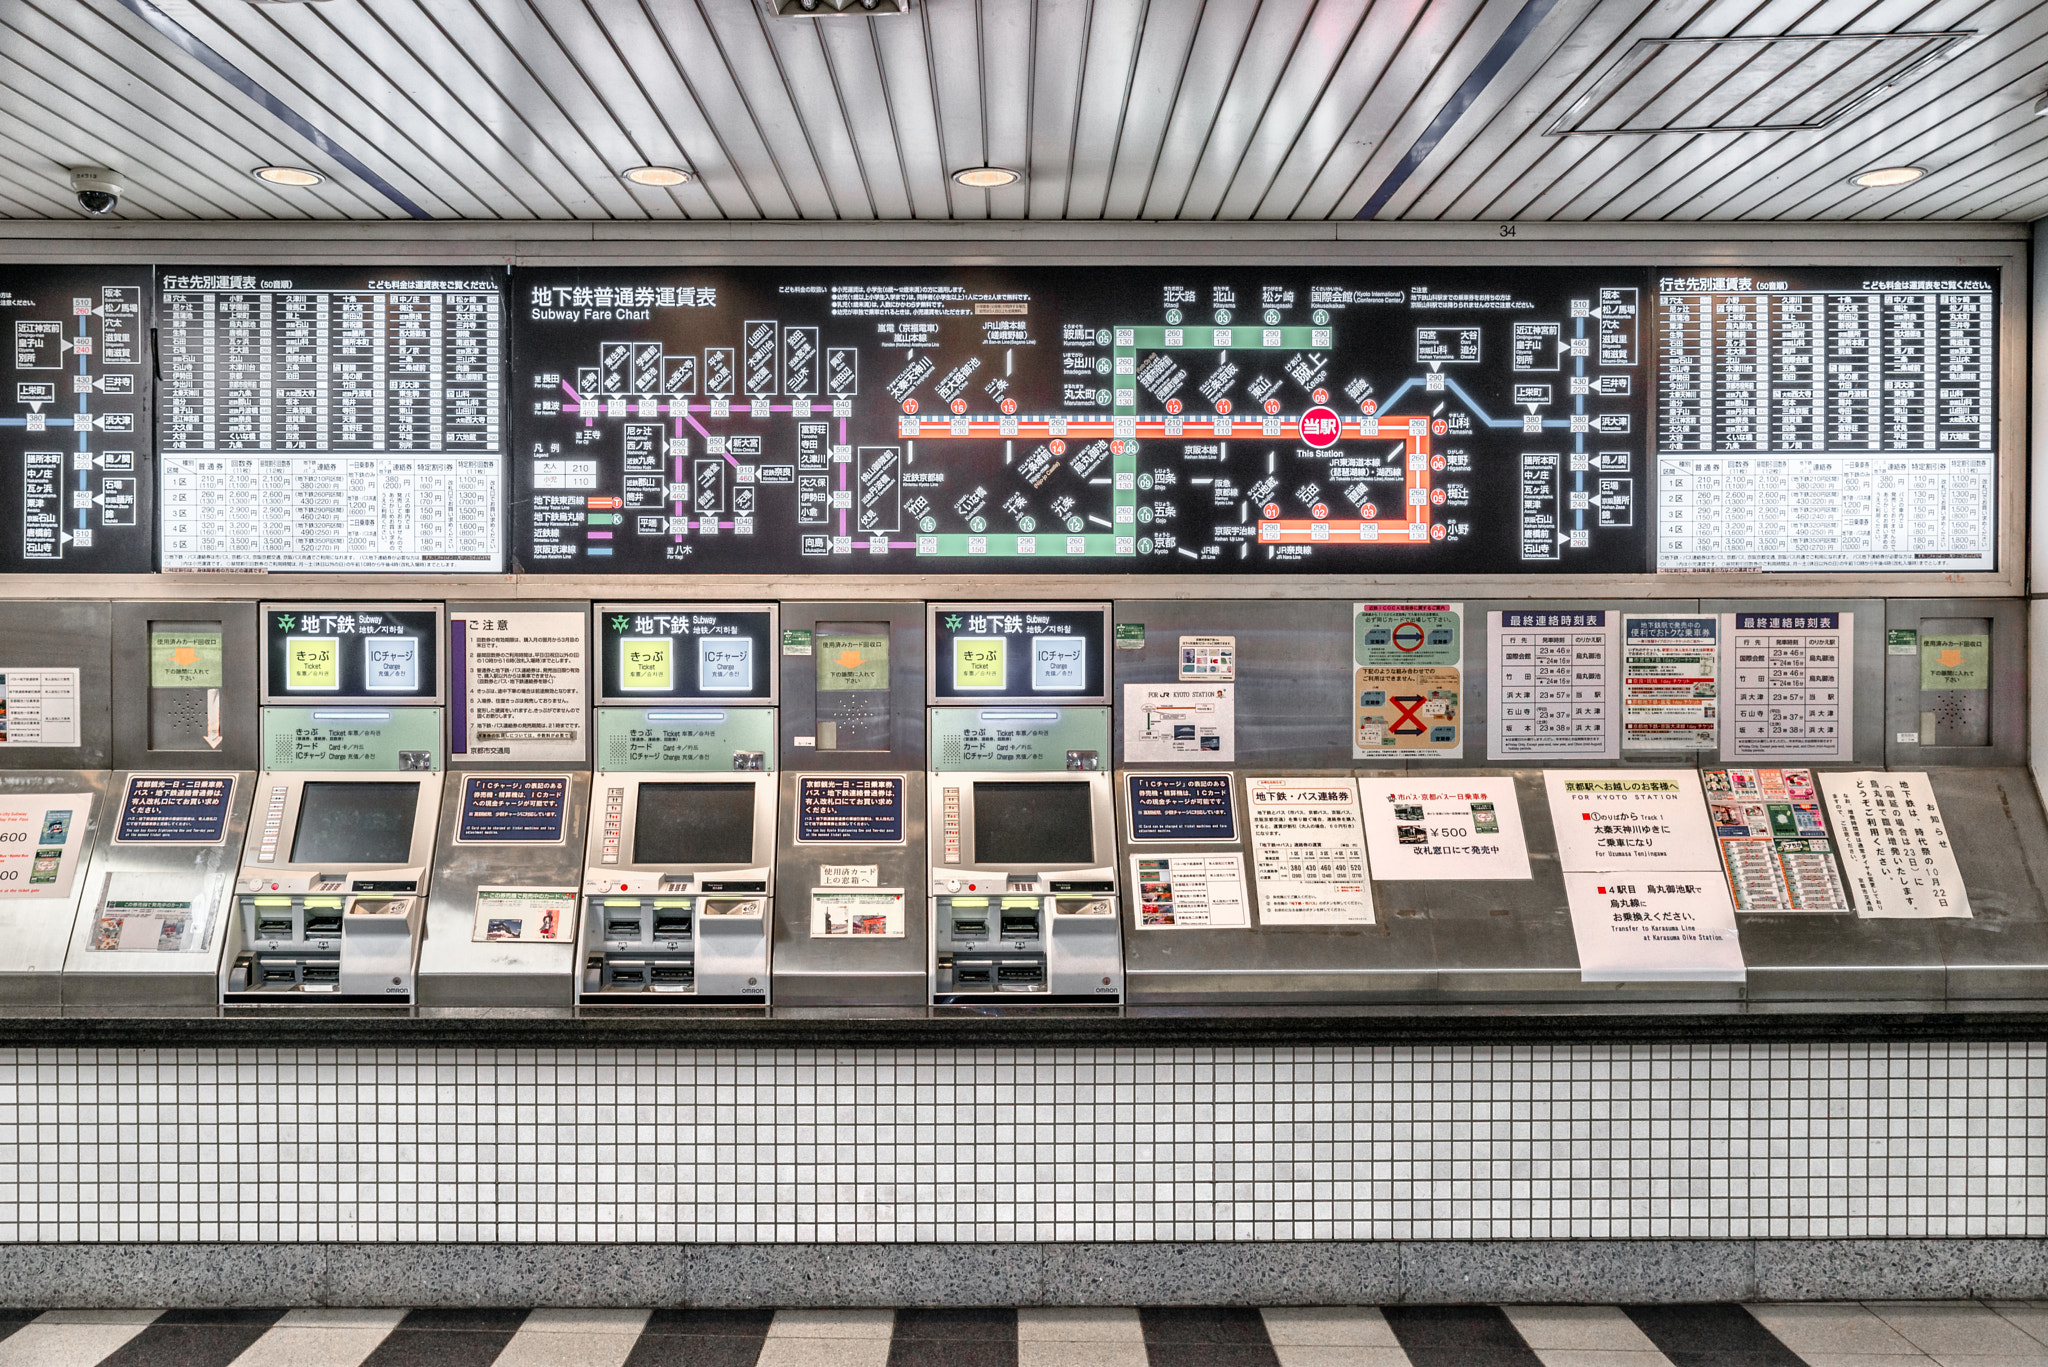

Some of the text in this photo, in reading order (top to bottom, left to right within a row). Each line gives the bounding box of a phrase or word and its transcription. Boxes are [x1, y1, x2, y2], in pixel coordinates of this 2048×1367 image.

[1500, 225, 1516, 237] 34
[163, 276, 256, 289] 行き先別運賃表
[368, 280, 499, 290] こども料金は運賃表をご覧ください。
[1660, 277, 1752, 291] 行き先別運賃表
[1863, 281, 1991, 290] こども料金は運賃表をご覧ください。
[105, 289, 122, 297] 坂本
[532, 286, 717, 308] 地下鉄普通券運賃表
[1164, 290, 1196, 302] 北大路
[1214, 291, 1234, 302] 北山
[1263, 291, 1294, 302] 松ヶ崎
[1312, 292, 1352, 302] 国際会館
[1603, 291, 1619, 299] 坂本
[531, 308, 650, 321] Subway Fare Chart
[1603, 321, 1619, 329] 穴太
[1064, 329, 1095, 340] 鞍馬口
[1461, 331, 1477, 339] 大谷
[1517, 326, 1557, 335] 近江神宮前
[1573, 339, 1587, 347] 460
[1461, 346, 1477, 354] 追分
[1064, 357, 1095, 368] 今出川
[1517, 356, 1533, 365] 別所
[105, 378, 130, 386] 三井寺
[1305, 370, 1327, 392] Keage
[1428, 374, 1442, 382] 290
[1602, 379, 1627, 387] 三井寺
[1064, 389, 1095, 399] 丸太町
[1518, 388, 1542, 397] 上栄町
[105, 416, 130, 425] 浜大津
[1449, 418, 1470, 428] 山科
[1602, 417, 1627, 426] 浜大津
[1304, 420, 1336, 435] 当駅
[627, 441, 652, 450] 西ノ京
[733, 438, 758, 448] 新大宮
[801, 440, 818, 449] 寺田
[1185, 446, 1217, 454] 京阪本線
[801, 455, 826, 464] 久津川
[1448, 455, 1468, 466] 東野
[1602, 456, 1627, 465] 島ノ関
[572, 464, 589, 473] 210
[903, 473, 943, 482] 近鉄京都線
[1154, 472, 1176, 484] 四条
[1525, 471, 1549, 480] 中ノ庄
[573, 477, 589, 486] 110
[801, 478, 826, 488] 大久保
[534, 496, 584, 505] 地下鉄東西線
[1154, 506, 1176, 517] 五条
[534, 529, 560, 538] 近鉄線
[1448, 524, 1468, 534] 小野
[1154, 536, 1176, 548] 京都
[1202, 546, 1219, 554] JR線
[1525, 545, 1549, 554] 石山寺
[302, 615, 382, 633] 地下鉄 Subway
[470, 620, 508, 630] ご注意
[636, 616, 716, 634] 地下鉄 Subway
[969, 615, 1049, 633] 地下鉄 Subway
[1510, 616, 1597, 626] 最終連絡時刻表
[1744, 618, 1831, 628] 最終連絡時刻表
[297, 651, 329, 661] きっぷ
[371, 651, 413, 662] ICチャージ
[630, 651, 663, 662] きっぷ
[705, 651, 747, 662] ICチャージ
[963, 650, 996, 661] きっぷ
[1038, 650, 1080, 661] ICチャージ
[384, 663, 400, 671] Charge
[296, 728, 318, 736] きっぷ
[630, 729, 652, 737] きっぷ
[296, 742, 318, 750] カード
[630, 743, 652, 751] カード
[296, 752, 326, 760] ICチャージ
[963, 752, 993, 760] ICチャージ
[1566, 782, 1679, 791] 京都駅へお越しのお客様へ
[1256, 792, 1348, 801] 地下鉄・バス連絡券
[1431, 828, 1467, 837] ¥500
[1594, 826, 1670, 834] 太秦天神川ゆきに
[1598, 838, 1653, 847] ご乗車になり
[1414, 846, 1499, 855] 改札窓口にて発売中
